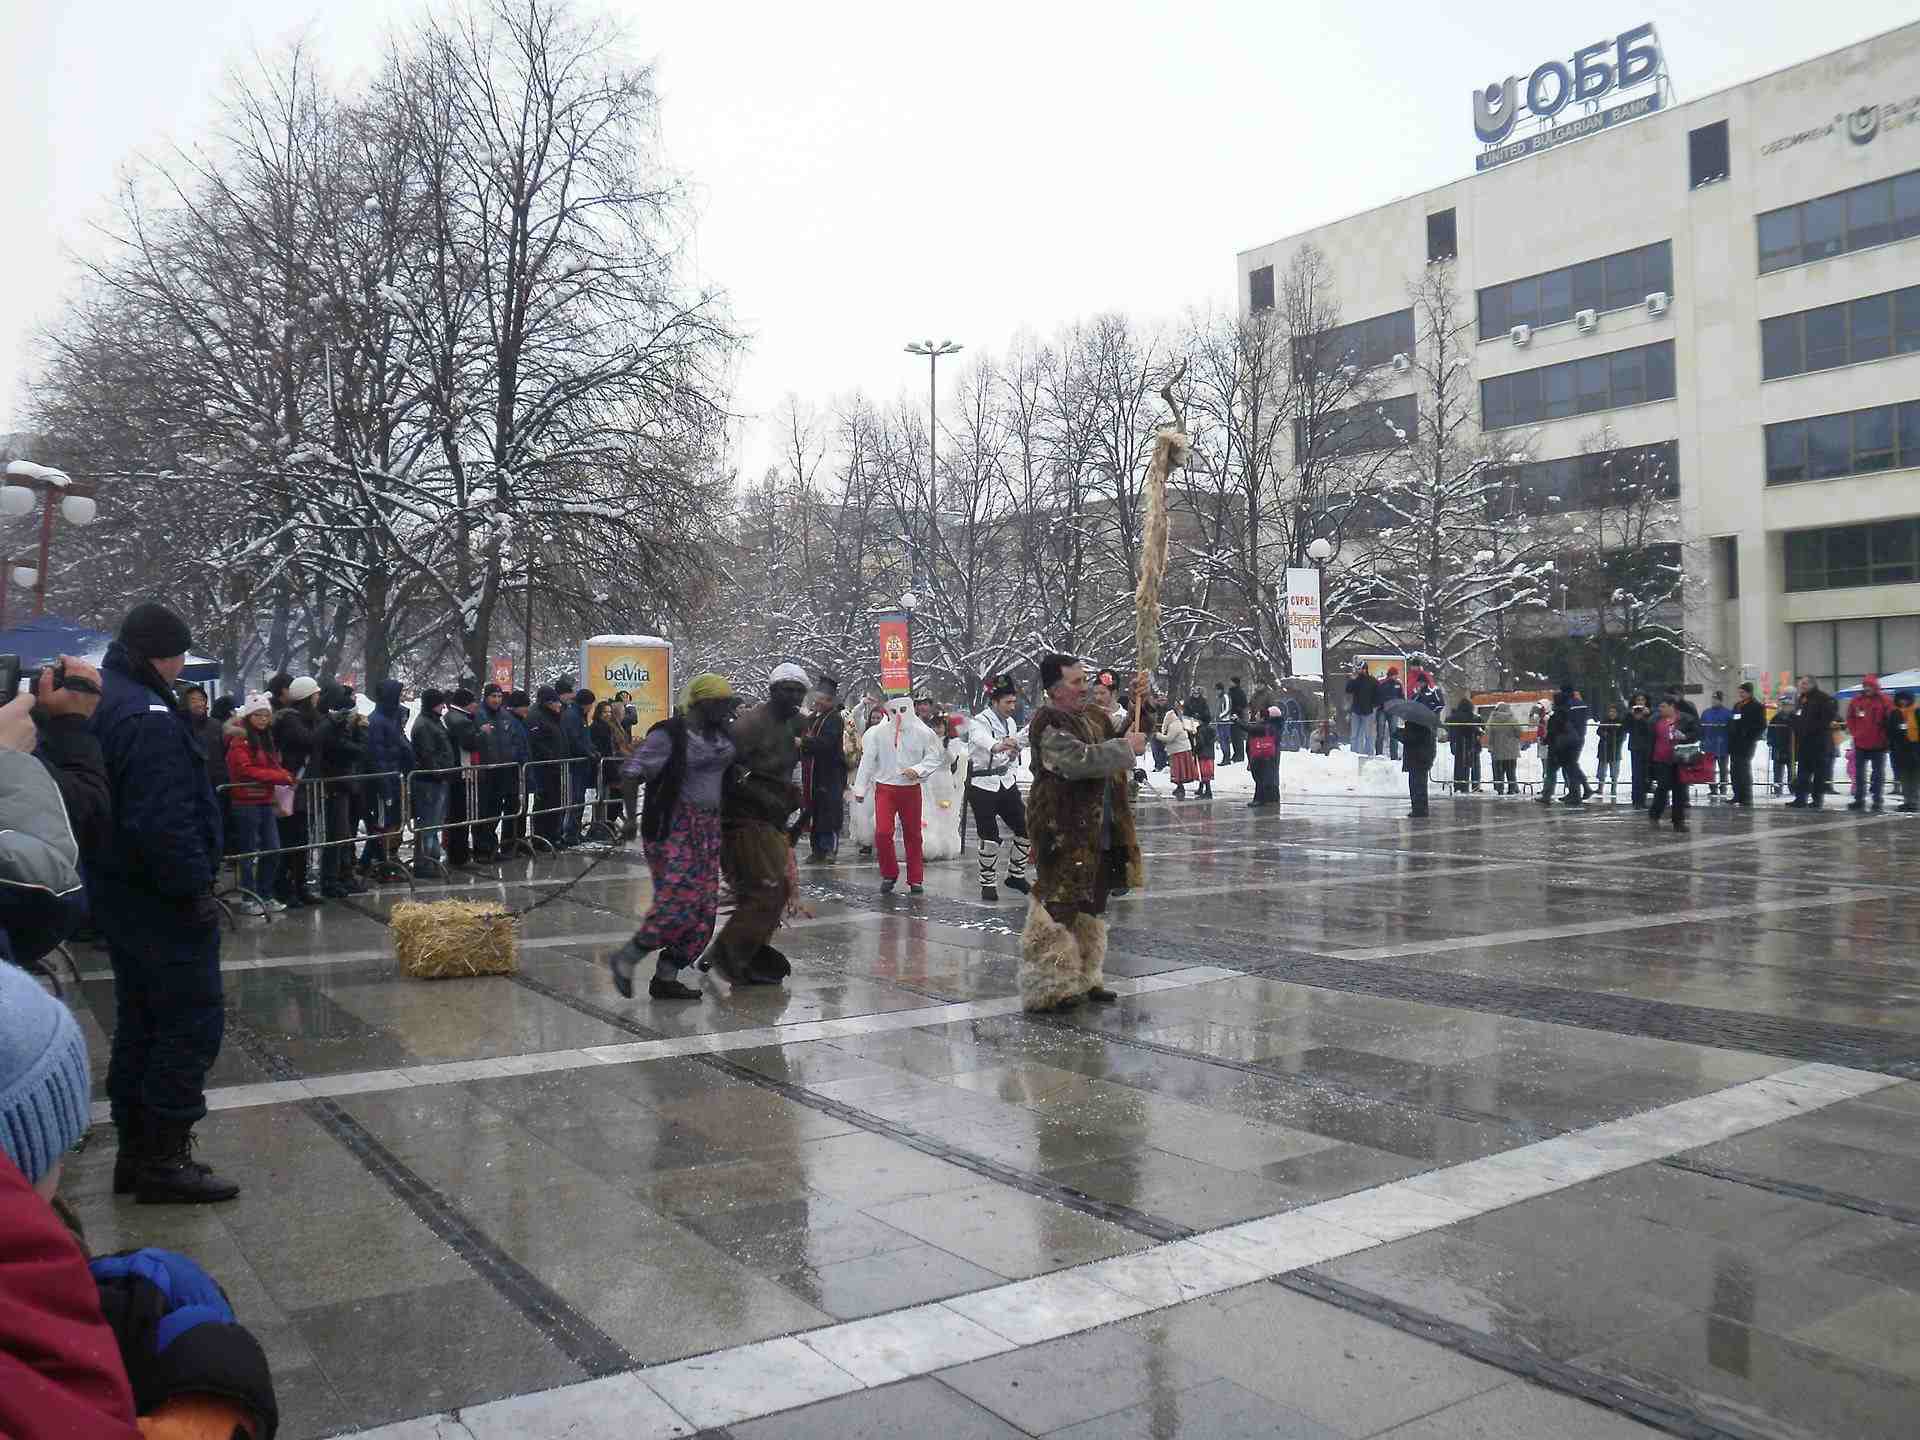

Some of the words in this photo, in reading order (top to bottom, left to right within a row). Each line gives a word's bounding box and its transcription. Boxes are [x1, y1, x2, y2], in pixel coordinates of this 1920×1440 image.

[1527, 22, 1659, 116] ОББ
[1482, 143, 1527, 166] UNITED
[1533, 115, 1604, 148] BULGARIAN
[1611, 97, 1650, 122] BANK
[604, 662, 650, 681] belVita
